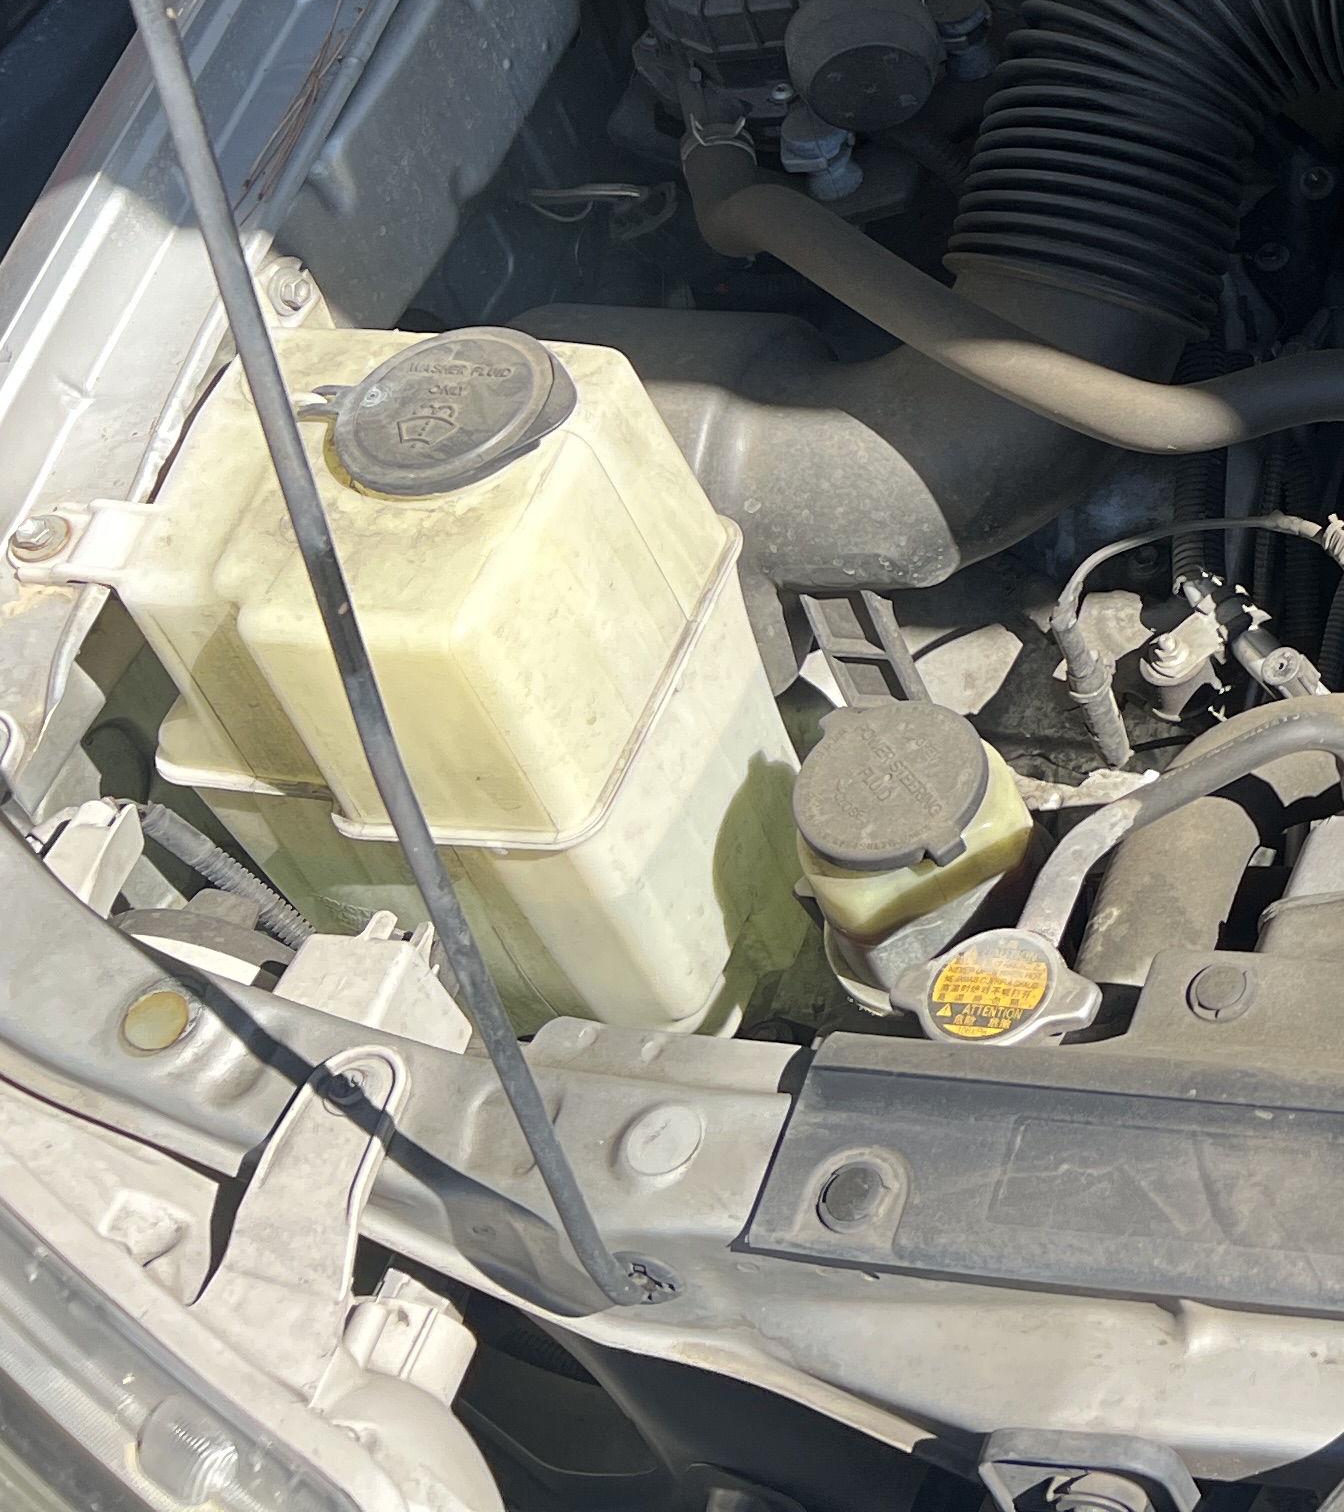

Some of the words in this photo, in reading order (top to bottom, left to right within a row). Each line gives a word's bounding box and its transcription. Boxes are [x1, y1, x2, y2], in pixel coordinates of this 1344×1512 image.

[857, 723, 896, 765] POWER
[889, 759, 943, 819] STEERING
[857, 767, 893, 802] FLUID
[834, 790, 867, 822] CLOSE
[961, 1004, 1024, 1020] ATTENTION
